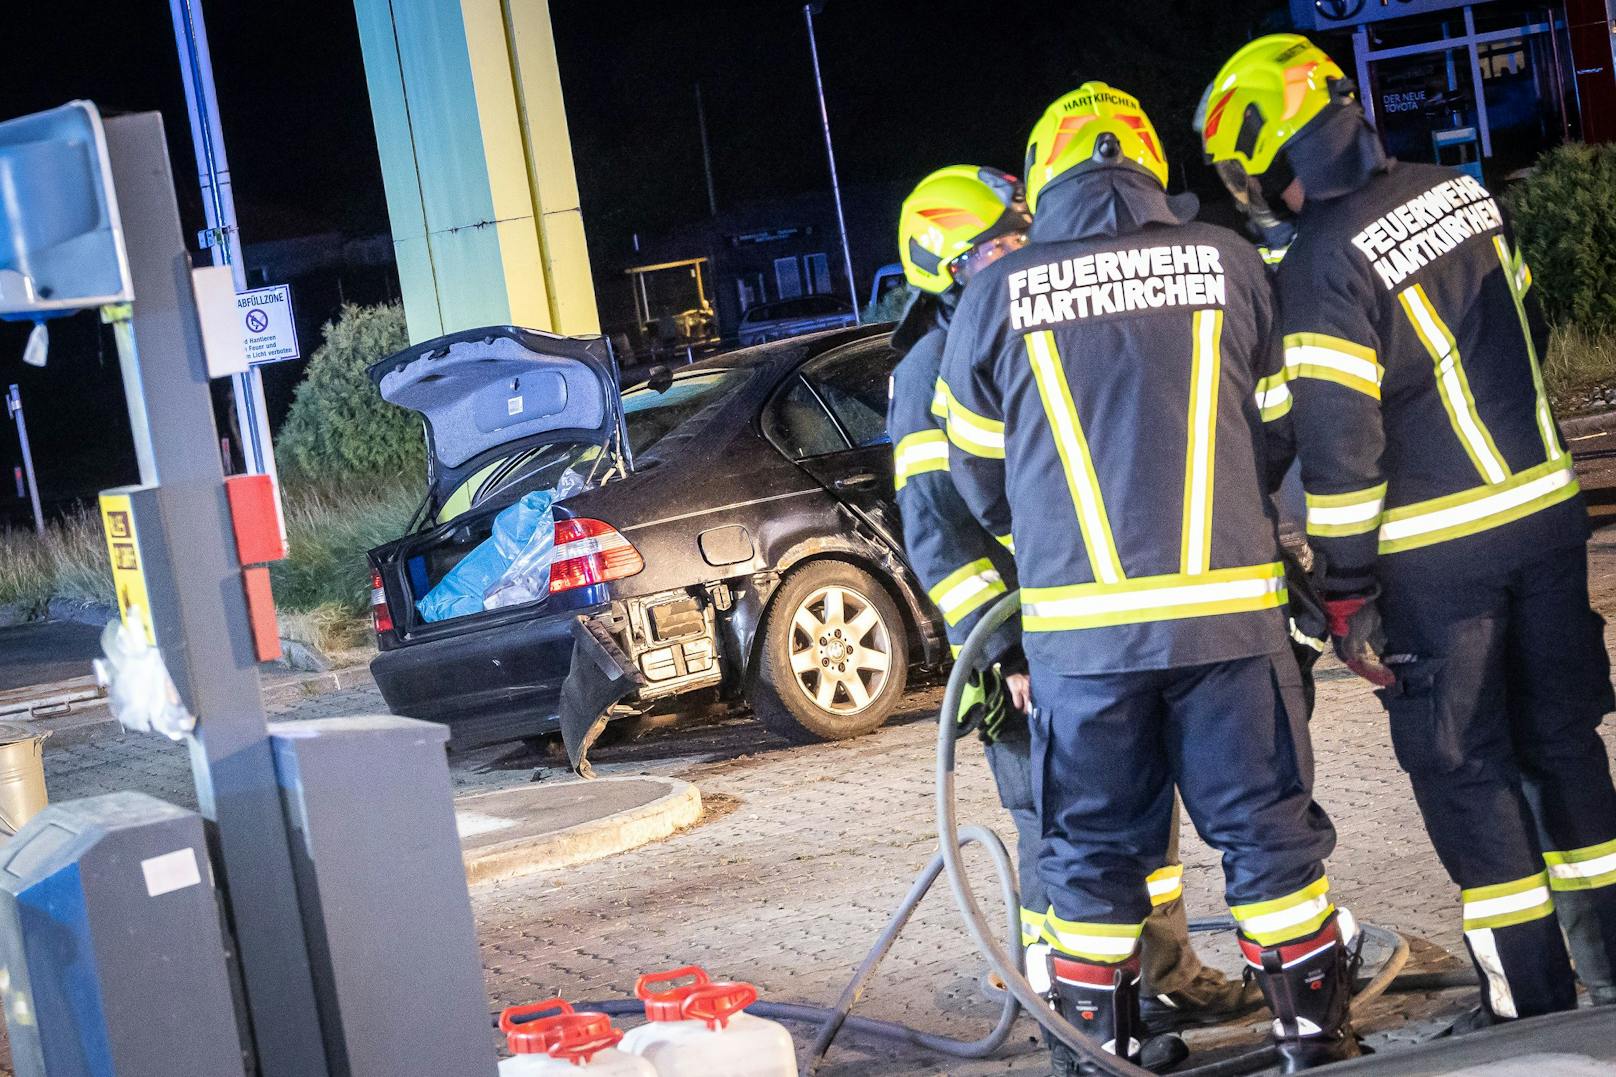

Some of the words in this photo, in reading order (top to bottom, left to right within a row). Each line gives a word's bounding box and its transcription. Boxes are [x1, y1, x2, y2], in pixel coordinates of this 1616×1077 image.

[1064, 93, 1137, 111] HARTKIRCHEN
[1383, 93, 1401, 104] DER
[1402, 90, 1426, 101] NEUE
[1384, 102, 1419, 112] TOYOTA
[1351, 175, 1490, 262] FEUERWEHR
[1373, 198, 1503, 290] HARTKIRCHEN
[1008, 245, 1224, 300] FEUERWEHR
[237, 293, 284, 308] ABFÜLLZONE
[1009, 274, 1226, 330] HARTKIRCHEN
[249, 335, 276, 344] Hantieren
[268, 347, 292, 355] verboten
